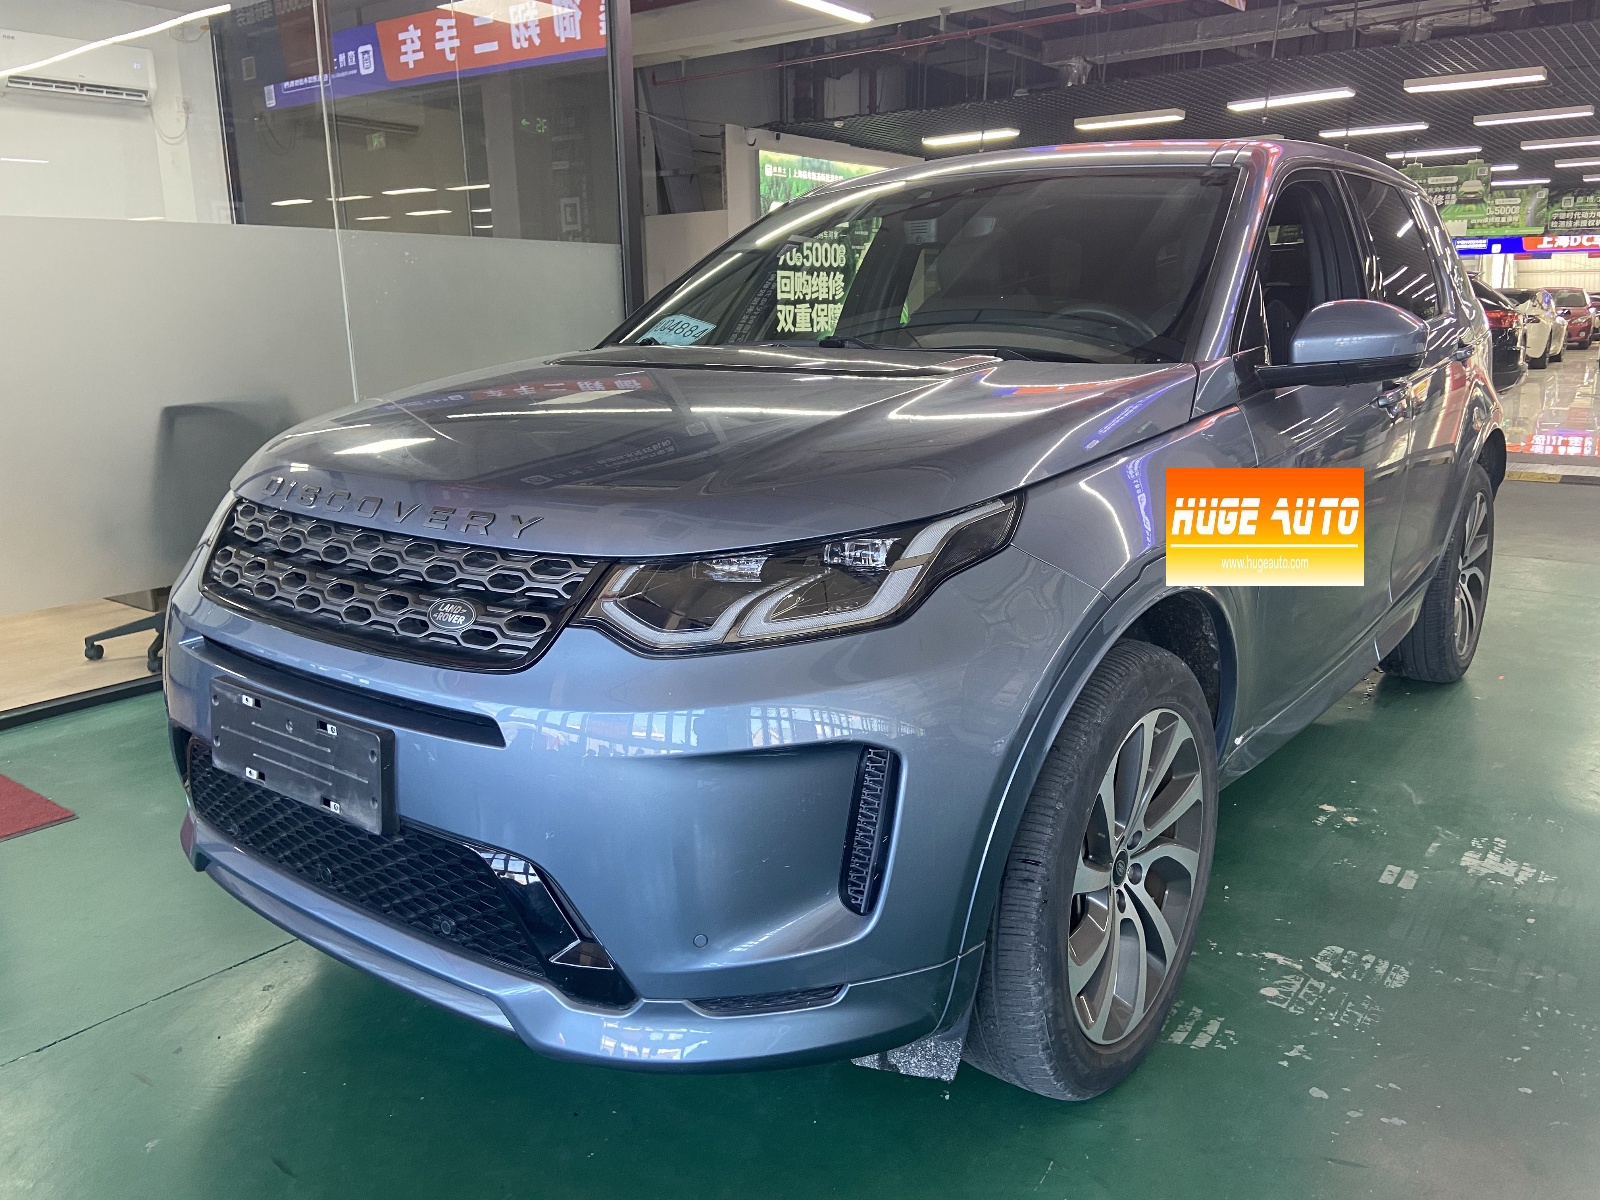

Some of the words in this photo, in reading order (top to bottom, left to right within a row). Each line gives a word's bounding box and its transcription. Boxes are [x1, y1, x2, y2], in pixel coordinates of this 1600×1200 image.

[776, 270, 845, 301] 回购维修
[260, 475, 545, 540] DISCOVERY
[436, 612, 466, 625] ROVER
[438, 603, 462, 614] LAND
